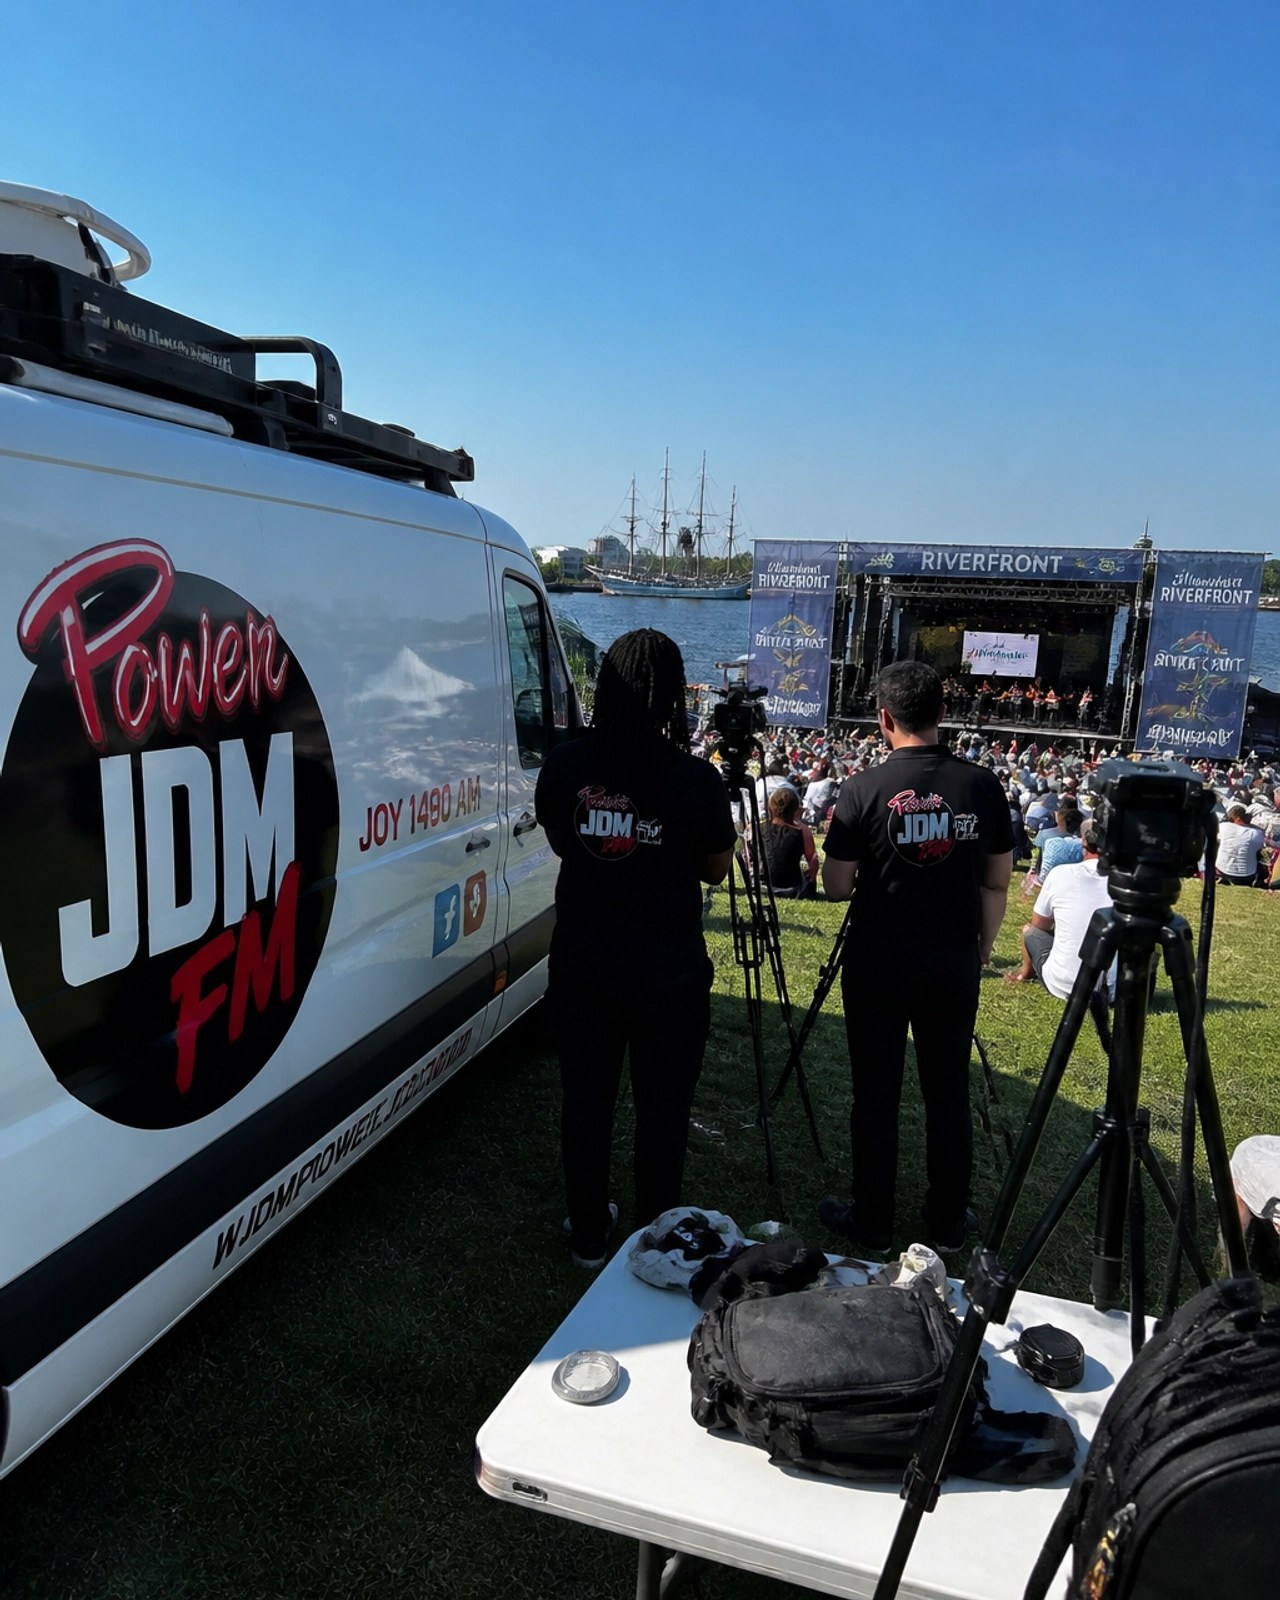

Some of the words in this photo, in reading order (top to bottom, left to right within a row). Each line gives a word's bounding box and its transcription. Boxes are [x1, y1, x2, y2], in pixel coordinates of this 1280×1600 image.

[920, 550, 1064, 574] RIVERFRONT
[1159, 586, 1253, 605] RIVERFRONT
[359, 798, 403, 853] JOY
[455, 775, 481, 818] AM
[579, 808, 634, 839] JDM
[896, 811, 949, 845] JDM
[58, 731, 295, 988] JDM
[170, 860, 301, 1096] FM
